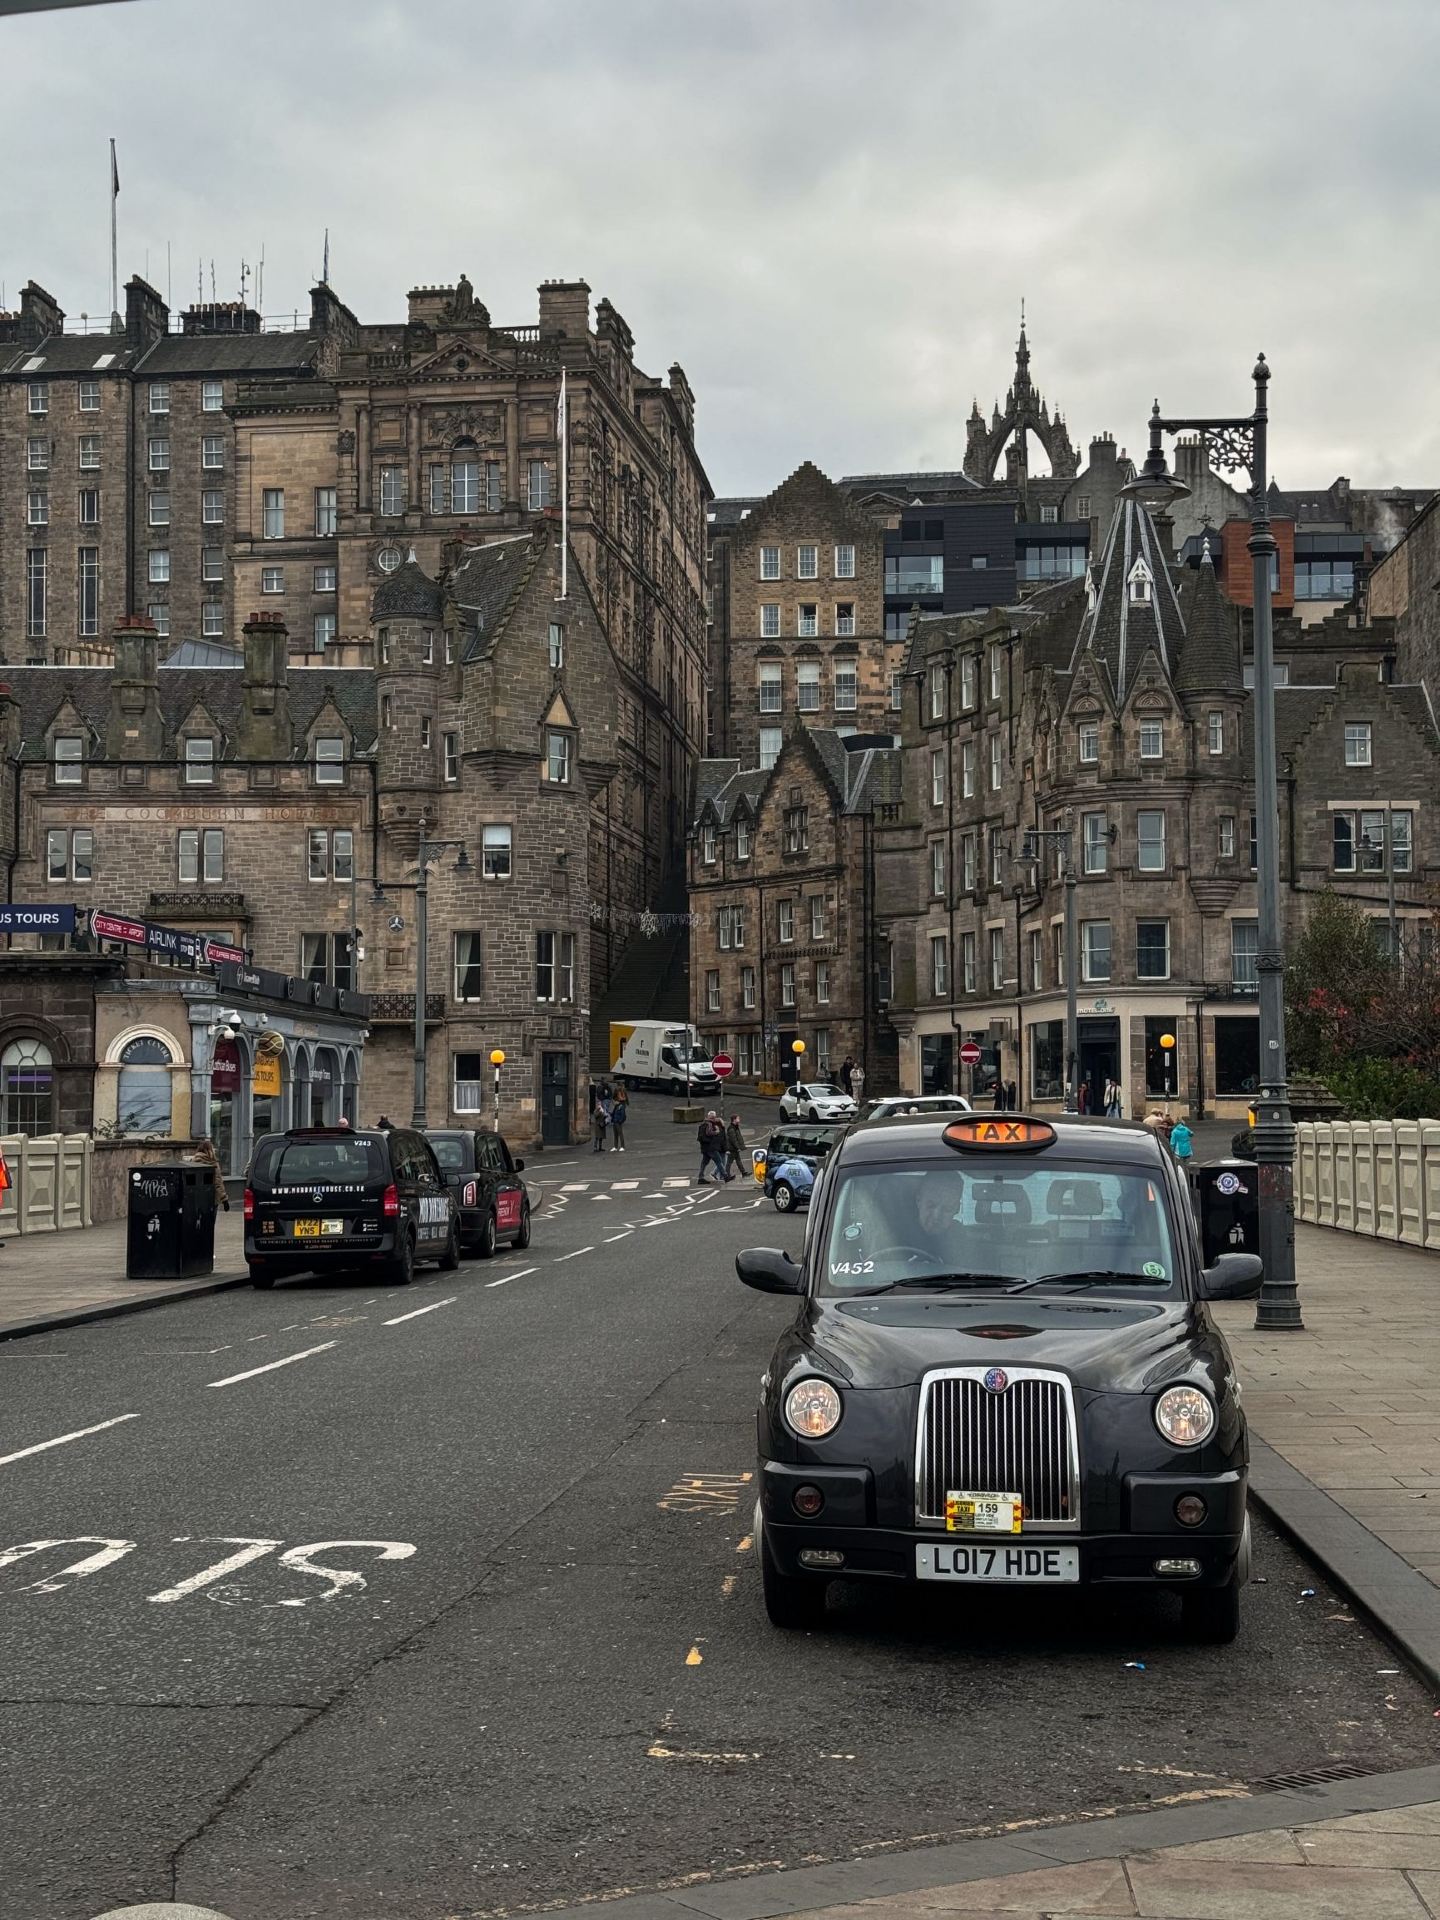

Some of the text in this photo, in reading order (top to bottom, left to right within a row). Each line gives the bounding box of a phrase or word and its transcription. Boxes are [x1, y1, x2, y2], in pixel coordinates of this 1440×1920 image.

[15, 913, 59, 924] TOURS
[149, 929, 177, 950] AIRLINK
[122, 1039, 144, 1059] TICKET
[968, 1124, 1031, 1141] TAXI
[299, 1226, 315, 1235] YNS
[830, 1261, 874, 1275] V452
[957, 1505, 970, 1513] TAXI
[978, 1503, 998, 1514] 159
[934, 1547, 1060, 1577] LO17 HDE
